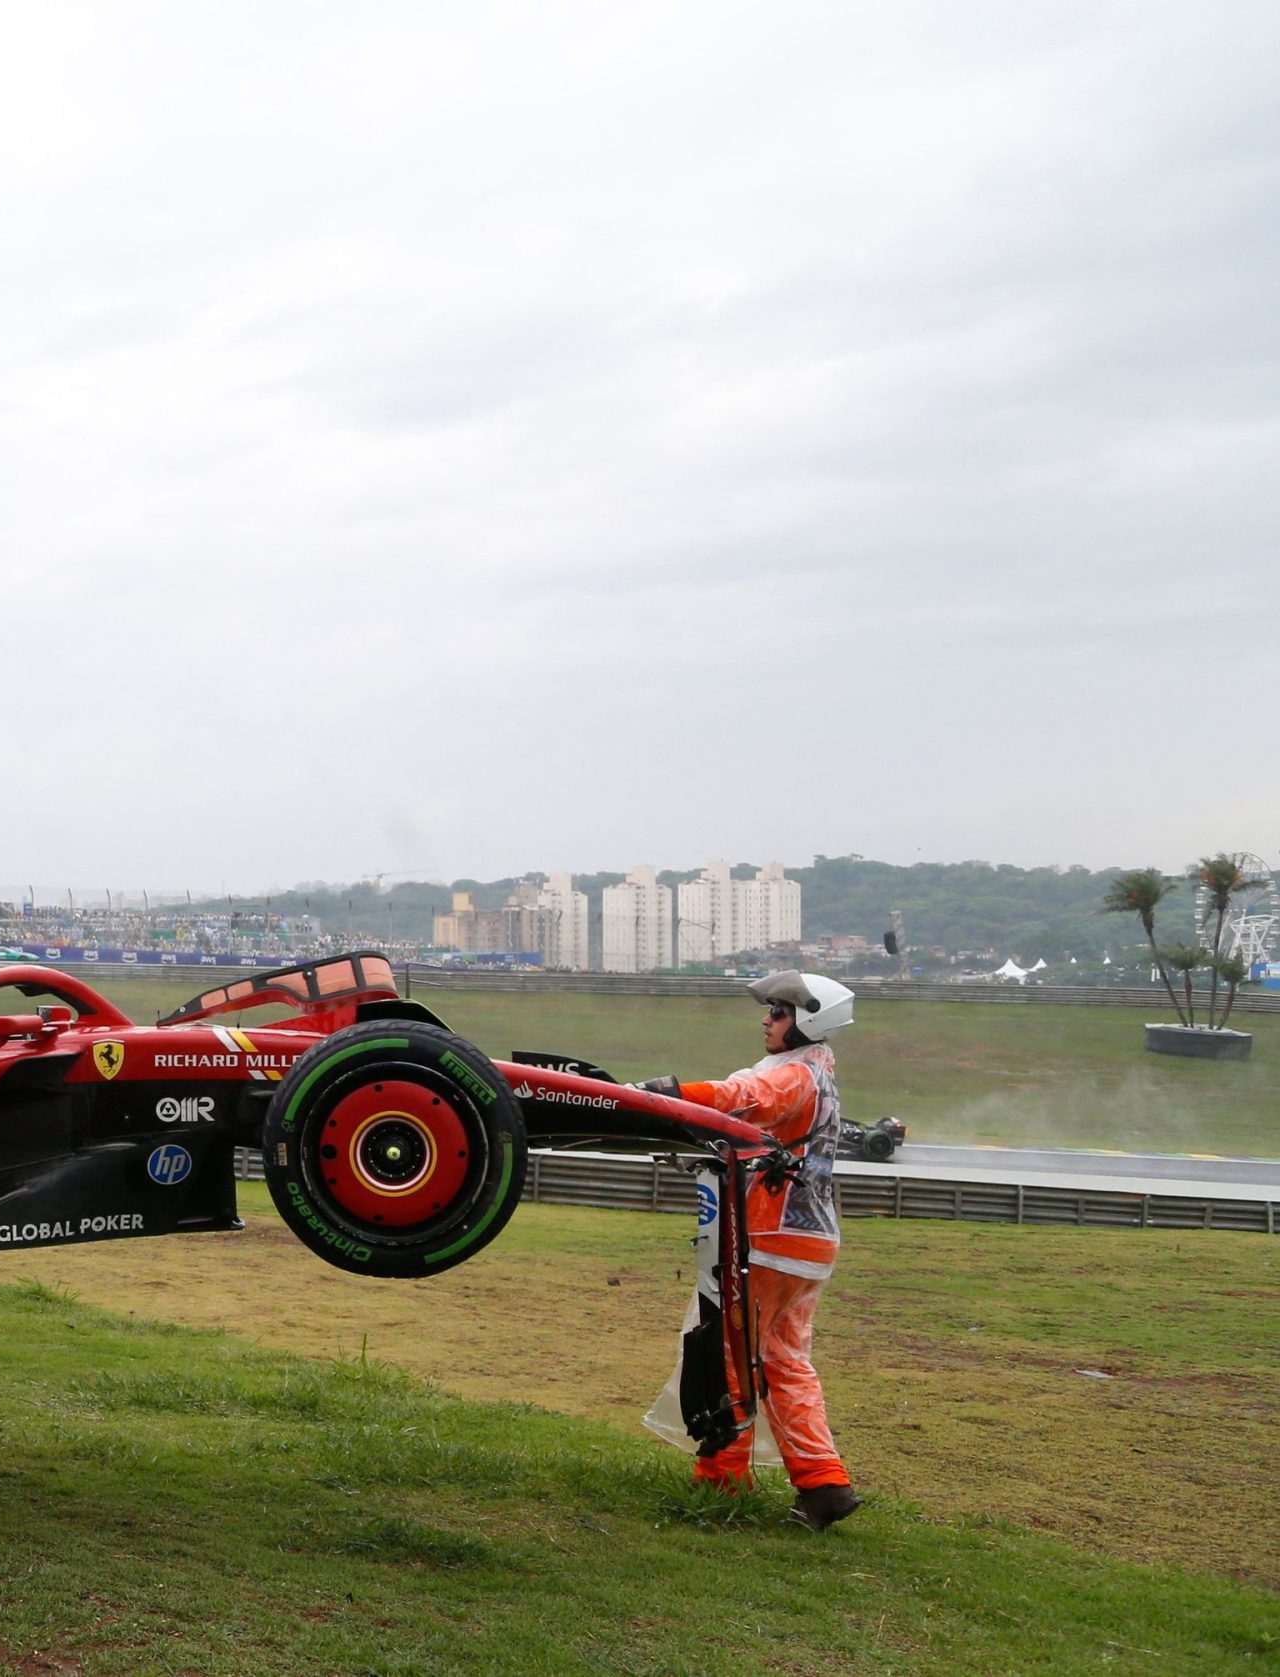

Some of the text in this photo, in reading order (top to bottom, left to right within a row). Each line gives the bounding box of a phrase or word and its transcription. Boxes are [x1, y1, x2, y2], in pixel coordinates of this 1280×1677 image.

[46, 948, 61, 957] aws
[83, 950, 99, 959] aws
[122, 952, 138, 960] aws
[160, 954, 177, 963] aws
[201, 956, 217, 964] aws
[154, 1054, 238, 1067] RICHARD
[439, 1050, 498, 1105] PIRELLI
[535, 1087, 620, 1110] Santander
[154, 1145, 186, 1184] hp
[79, 1213, 144, 1234] POKER
[287, 1181, 373, 1262] Cinturato
[729, 1203, 742, 1301] V-Power
